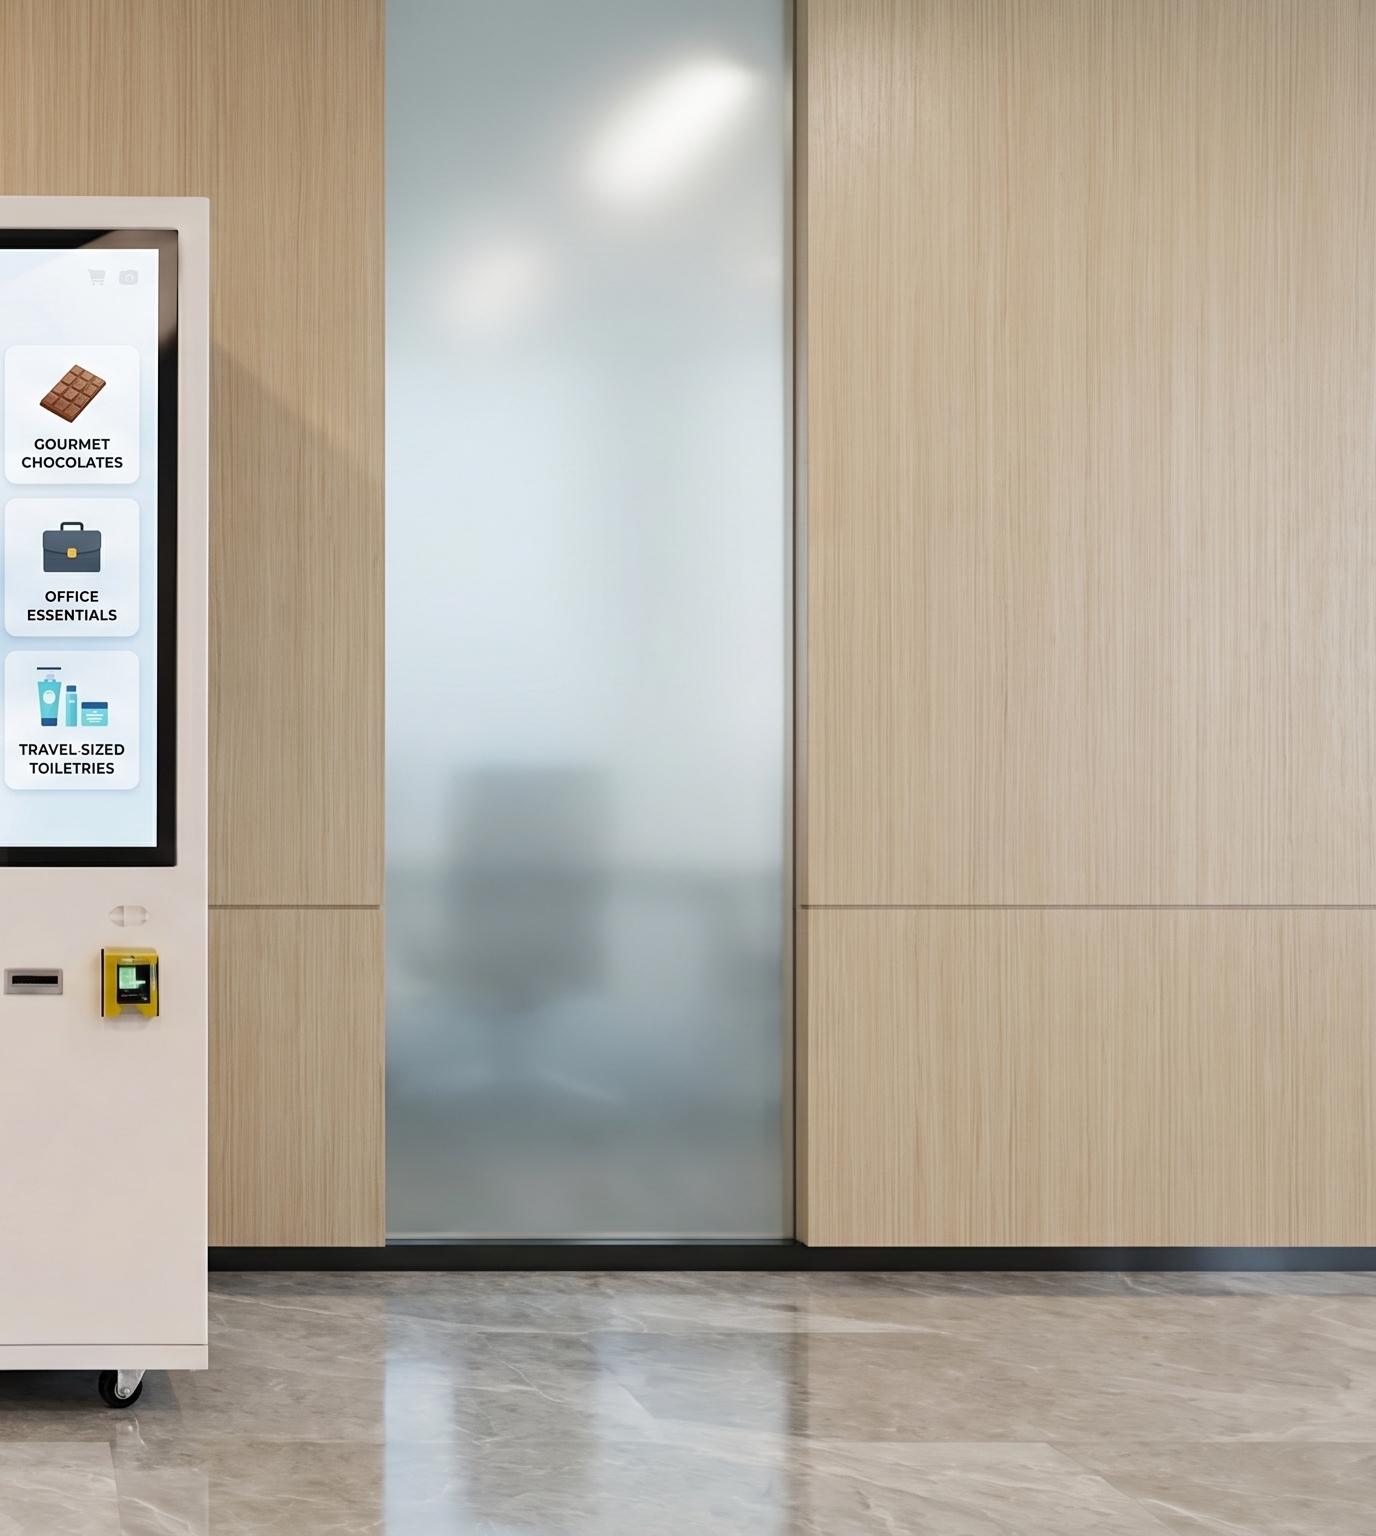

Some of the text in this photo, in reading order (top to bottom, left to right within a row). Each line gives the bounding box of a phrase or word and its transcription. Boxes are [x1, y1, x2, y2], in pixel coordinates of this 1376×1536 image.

[34, 438, 111, 451] GOURMET
[21, 456, 123, 469] CHOCOLATES
[44, 590, 99, 603] OFFICE
[27, 609, 118, 622] ESSENTIALS
[29, 762, 115, 775] TOILETRIES
